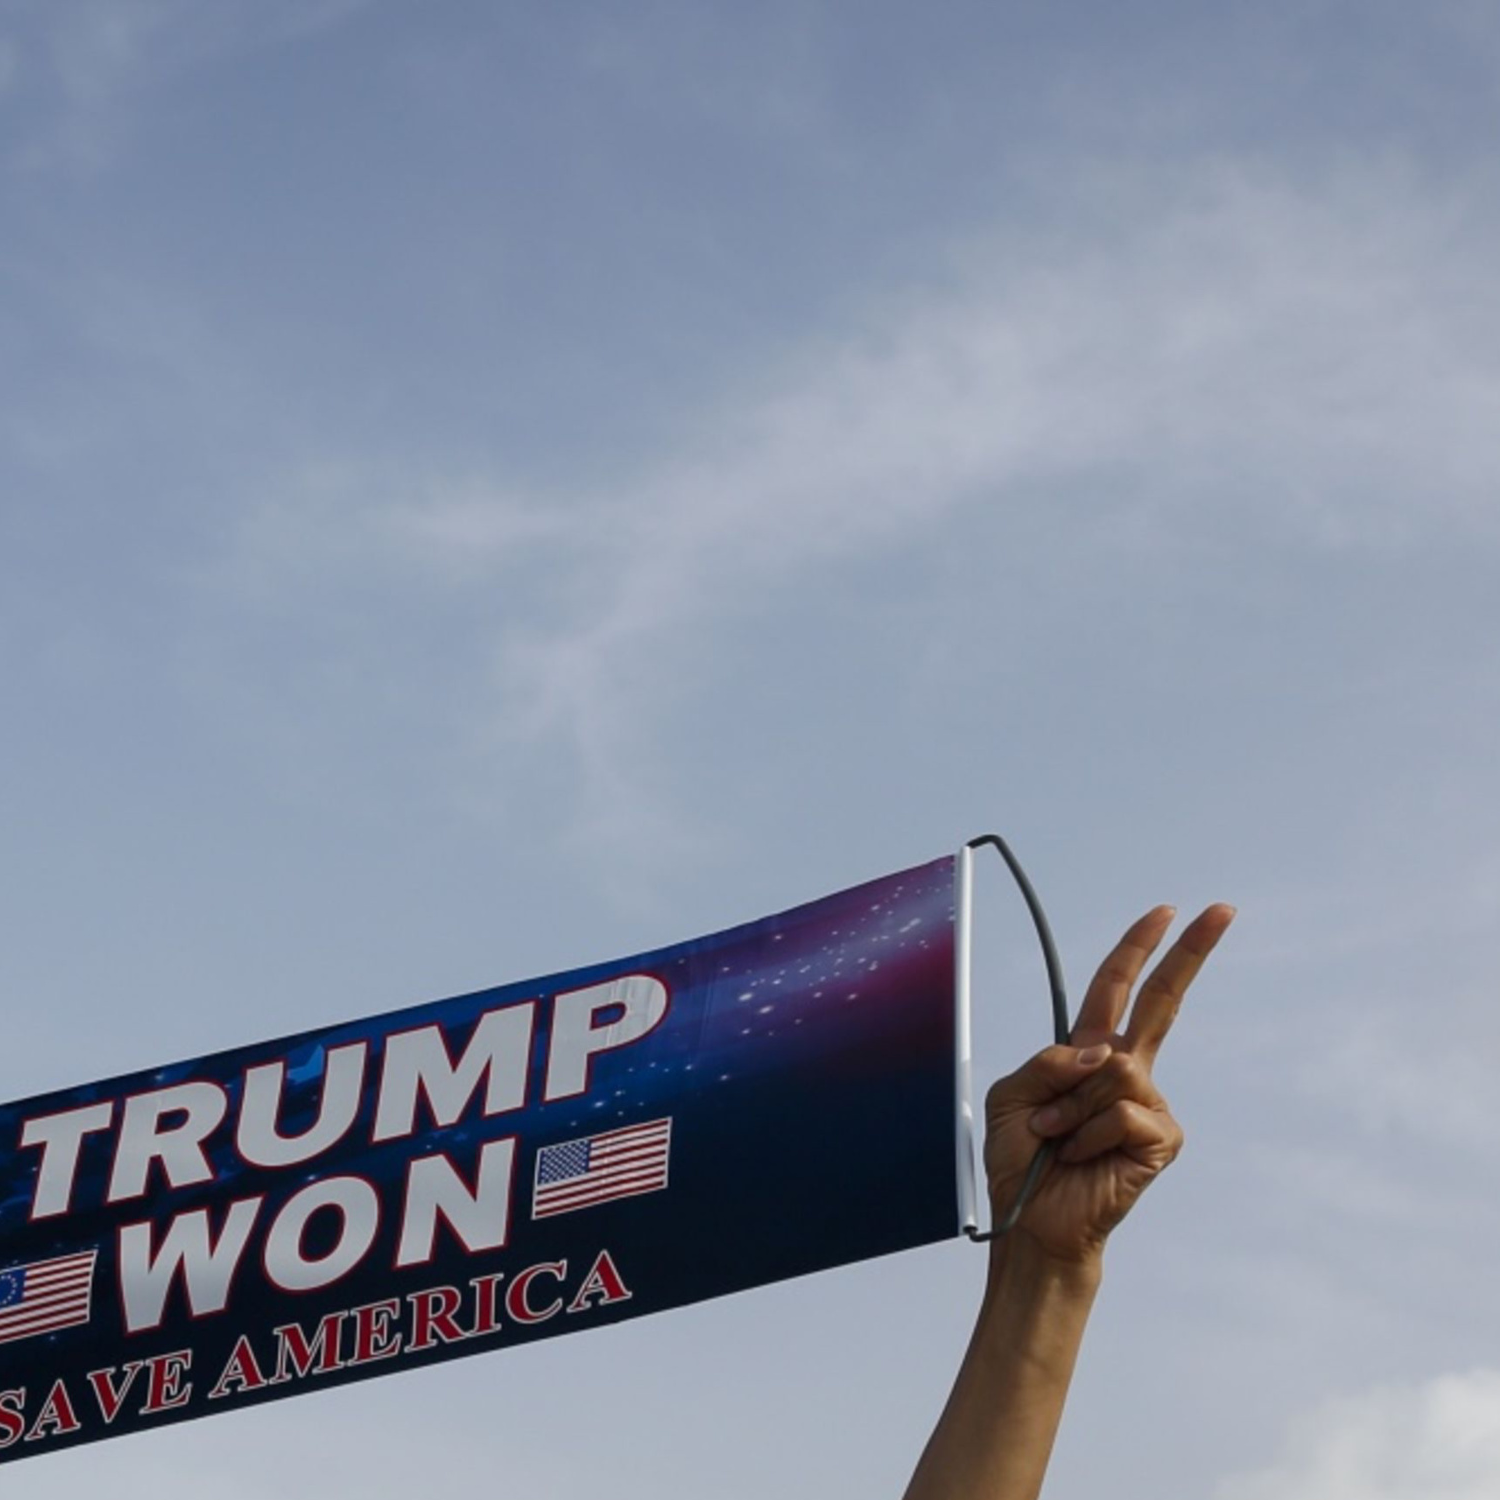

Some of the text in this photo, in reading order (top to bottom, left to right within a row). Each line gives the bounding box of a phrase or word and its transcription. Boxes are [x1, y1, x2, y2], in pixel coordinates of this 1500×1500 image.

[19, 973, 668, 1222] TRUMP
[116, 1136, 515, 1335] WON
[211, 1248, 632, 1399] AMERICA
